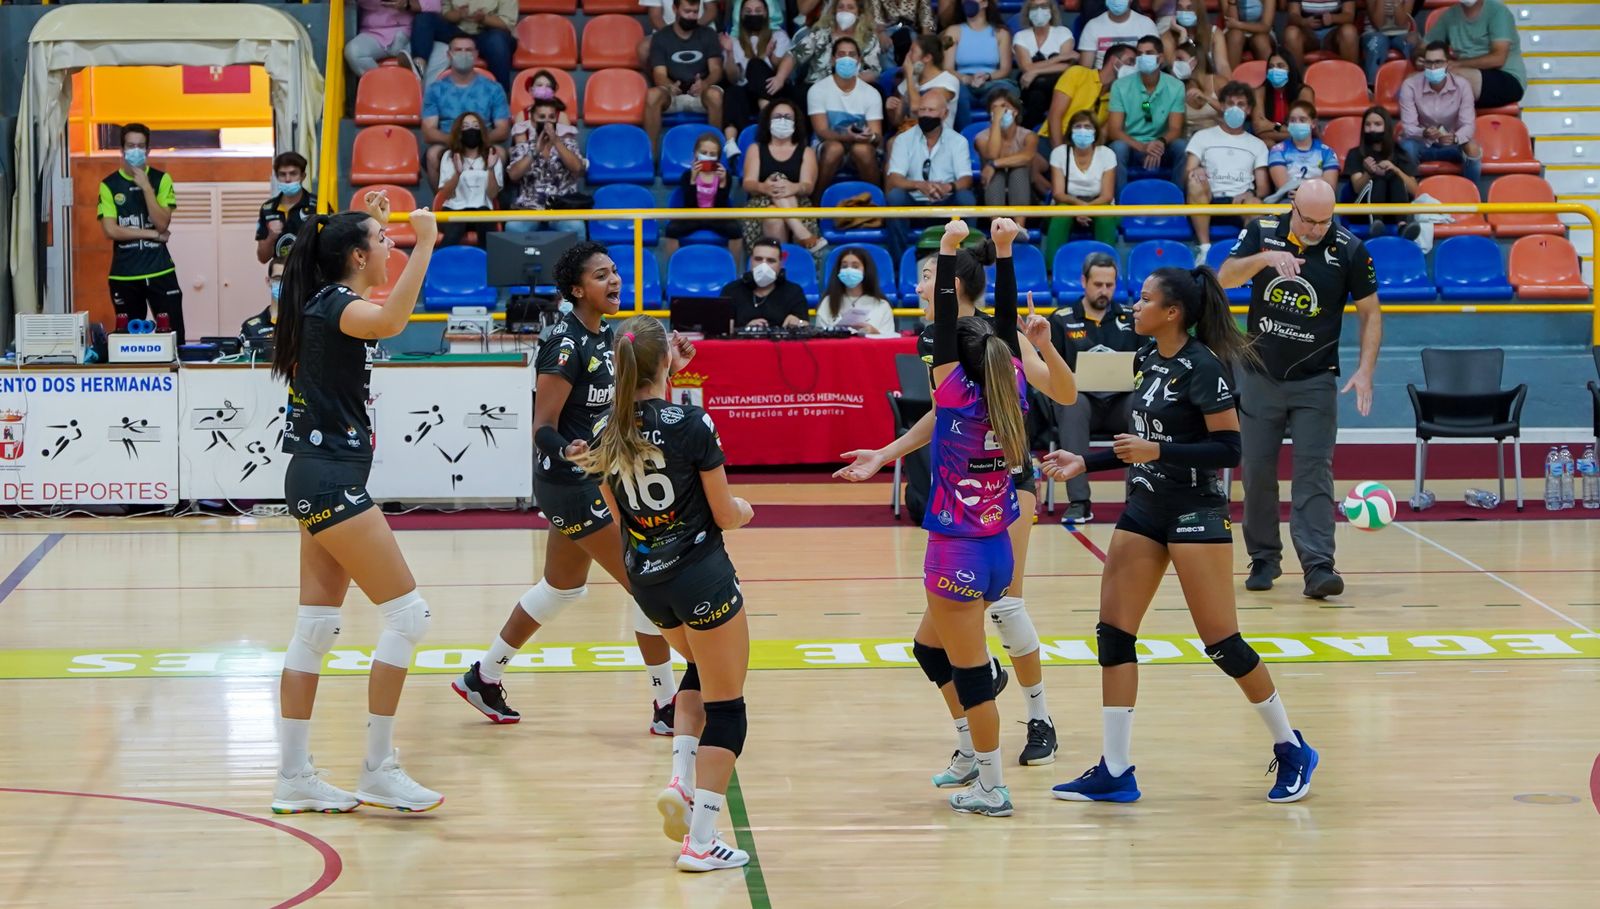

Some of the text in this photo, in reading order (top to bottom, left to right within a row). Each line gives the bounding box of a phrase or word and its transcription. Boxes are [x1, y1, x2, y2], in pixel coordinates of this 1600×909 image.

[1271, 288, 1311, 309] SHC
[1273, 323, 1315, 340] Valiente
[120, 345, 161, 353] MONDO
[42, 377, 75, 393] DOS
[81, 376, 173, 393] HERMANAS
[1142, 377, 1162, 407] 4
[708, 392, 864, 406] AYUNTAMIENTO DE DOS HERMANAS
[728, 407, 845, 419] Delegación de Deportes
[4, 482, 168, 500] DE DEPORTES
[937, 576, 983, 598] Divisa
